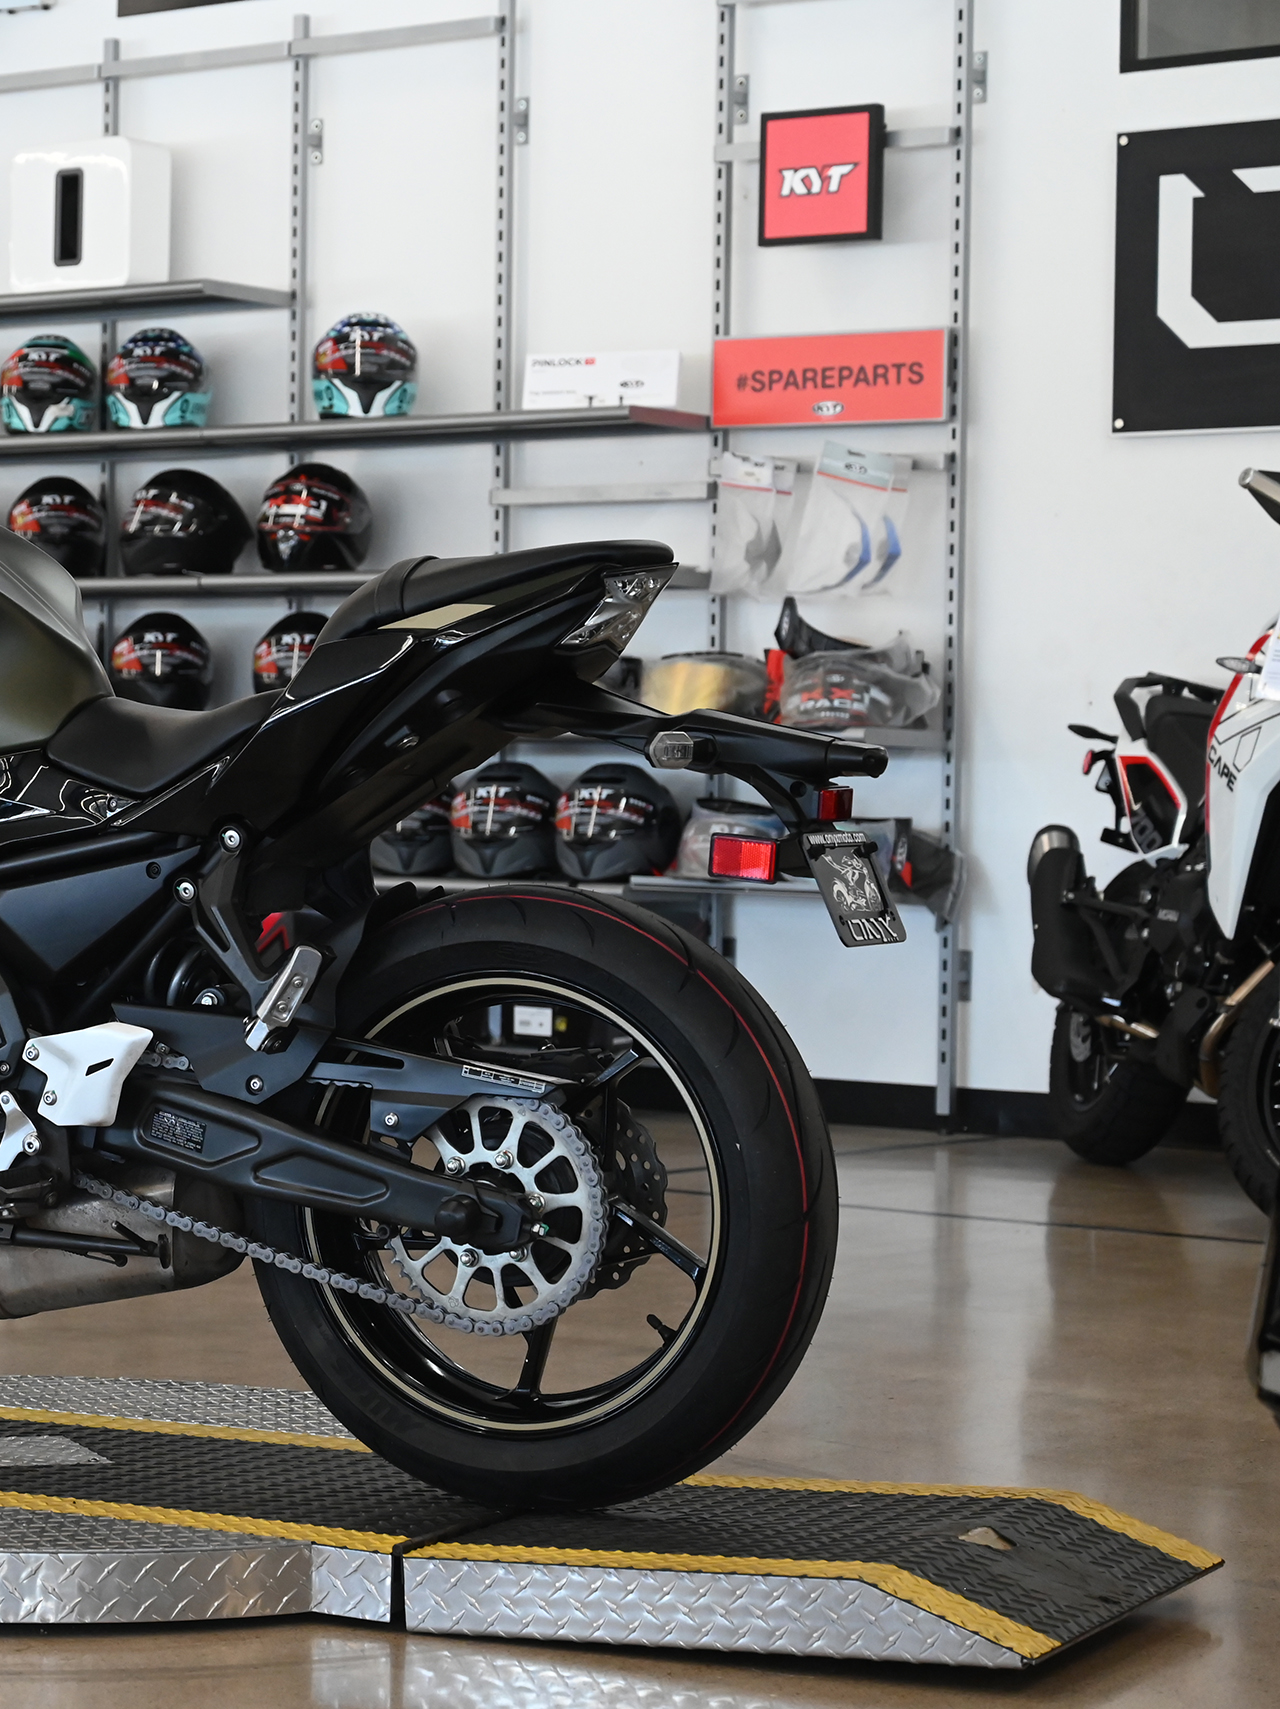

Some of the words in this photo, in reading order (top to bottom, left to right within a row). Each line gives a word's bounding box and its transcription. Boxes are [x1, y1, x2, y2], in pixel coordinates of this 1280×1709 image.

[779, 163, 860, 197] KYT
[735, 361, 925, 393] #SPAREPARTS
[807, 832, 867, 847] www.onyxmoto.com
[846, 914, 898, 942] ONYX
